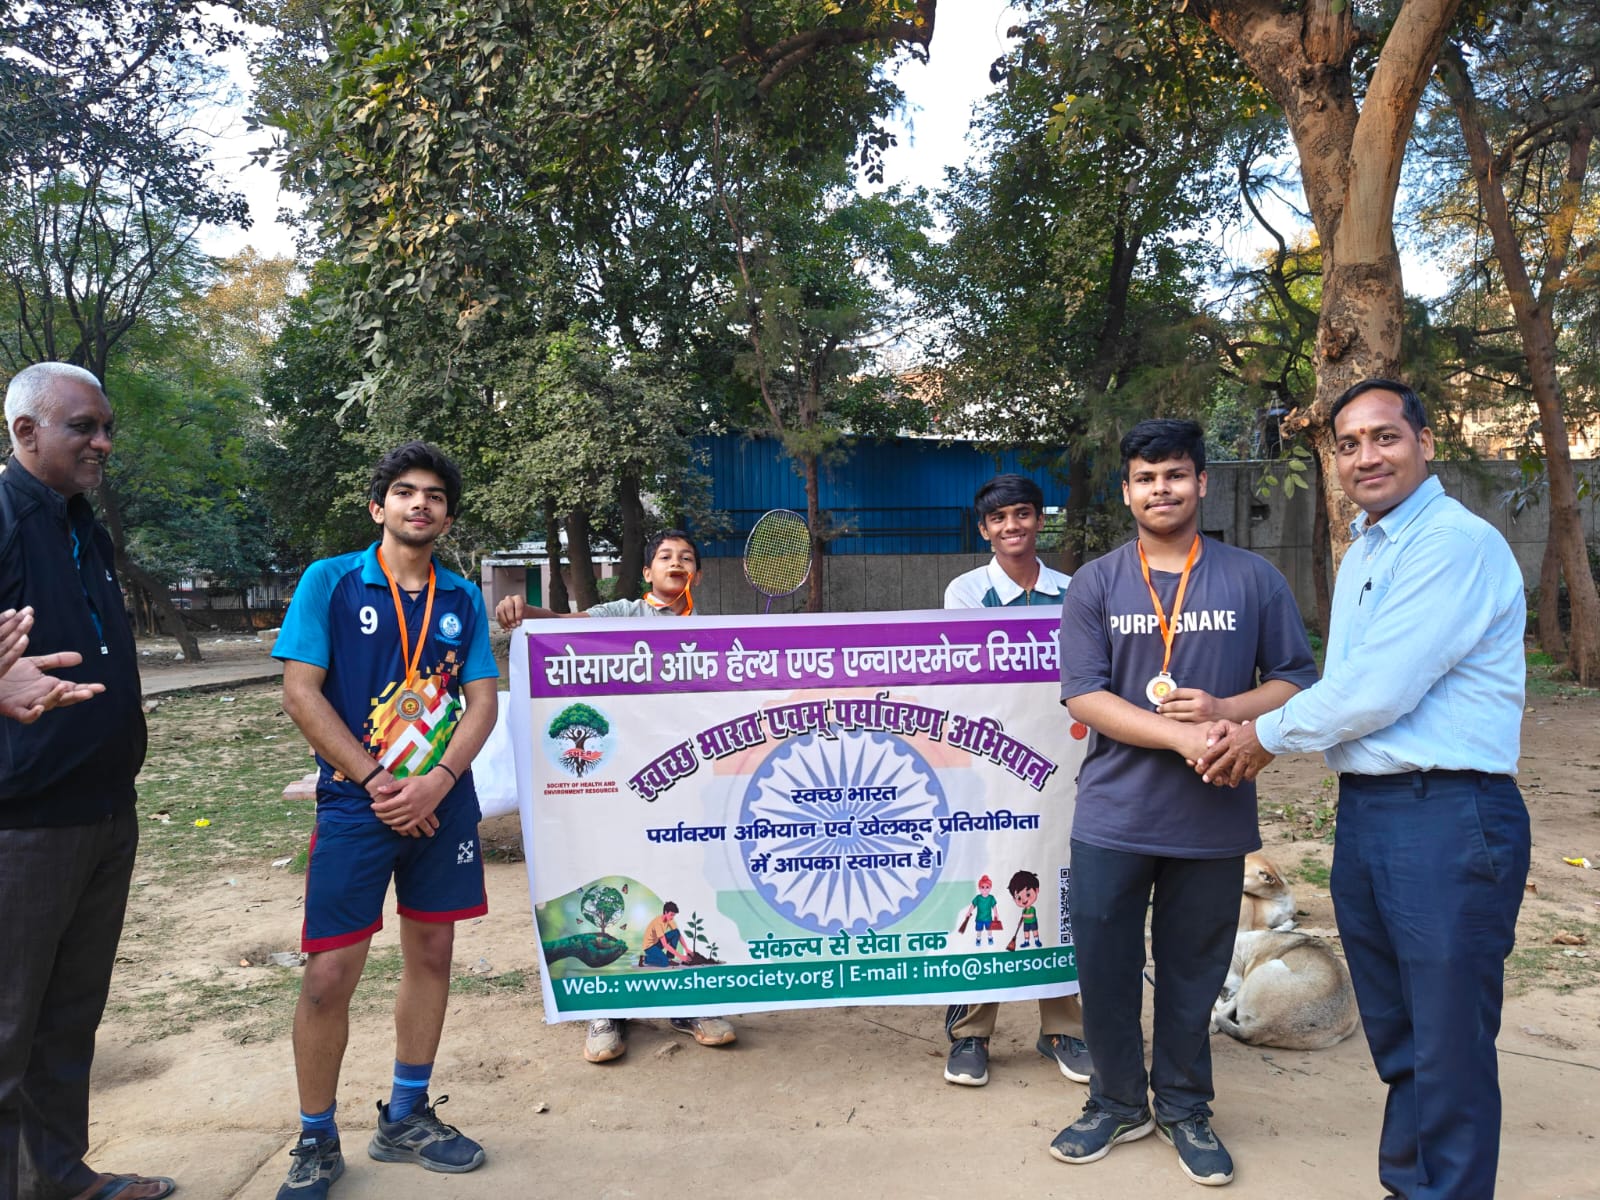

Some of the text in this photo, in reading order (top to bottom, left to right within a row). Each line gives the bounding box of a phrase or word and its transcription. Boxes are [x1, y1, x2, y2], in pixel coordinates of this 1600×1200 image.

[360, 605, 378, 635] 9
[1170, 609, 1237, 634] SNAKE
[544, 629, 1060, 686] सोसायटी ऑफ हैल्थ एण्ड एन्वायरमेन्ट रिसोर्से
[627, 691, 1057, 802] स्वच्छ भारत एवम् पर्यावरण अभियान
[543, 787, 619, 796] ENVIRONMENT RESOURCES
[790, 786, 898, 804] स्वच्छ भारत
[646, 809, 1041, 843] पर्यावरण अभियान एवं खेलकूद प्रतियोगिता
[750, 853, 772, 873] में
[774, 854, 842, 873] आपका
[846, 852, 913, 870] स्वागत
[748, 928, 949, 960] संकल्प से सेवा तक
[562, 976, 620, 996] Web.:
[625, 969, 834, 993] www.shersociety.org
[850, 962, 908, 982] E-mail
[924, 951, 1075, 980] info@shersociet
